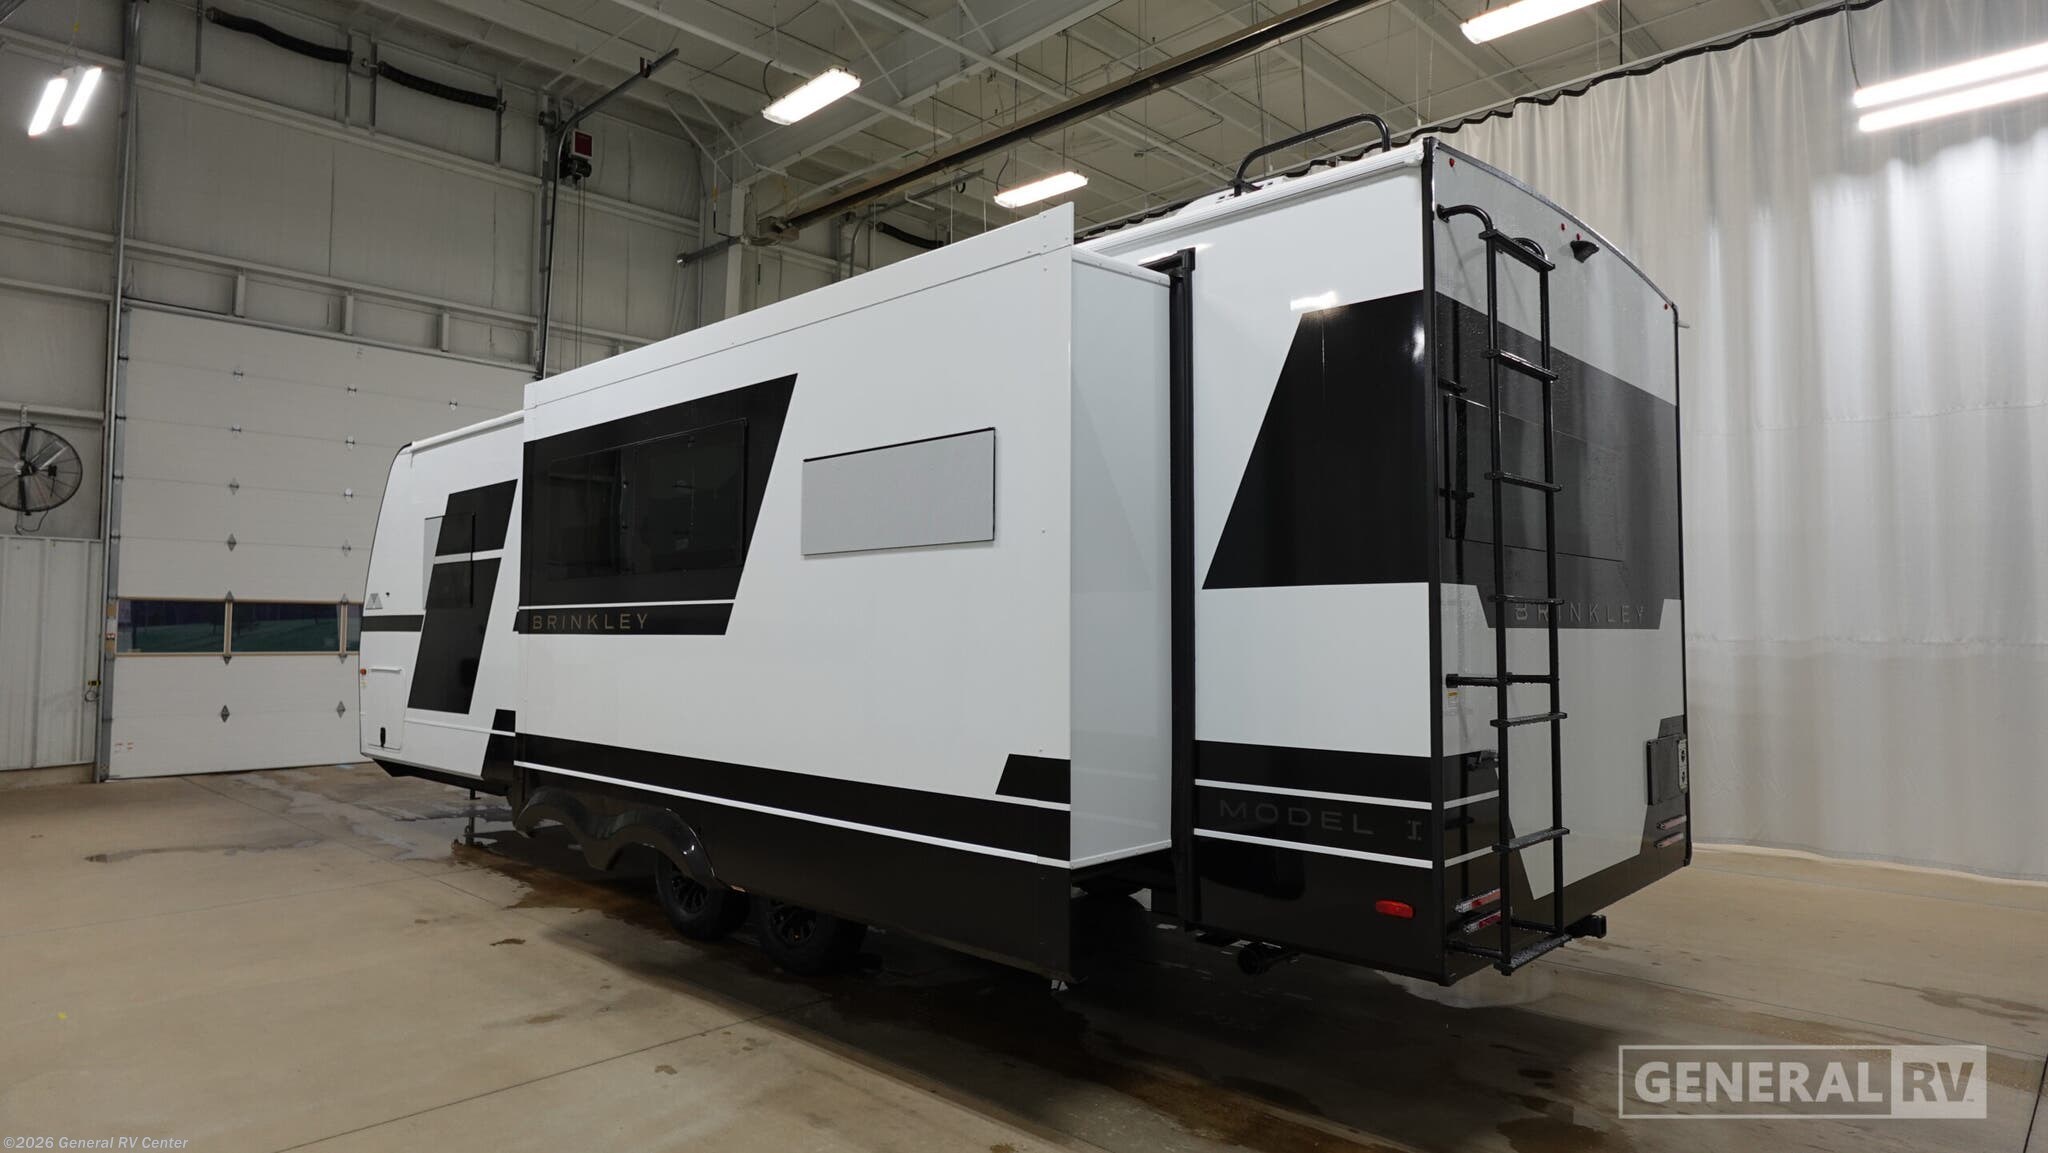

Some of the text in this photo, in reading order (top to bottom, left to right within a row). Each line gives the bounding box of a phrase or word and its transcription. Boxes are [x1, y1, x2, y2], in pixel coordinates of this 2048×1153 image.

[532, 613, 648, 630] BRINKLEY
[1513, 602, 1645, 624] BRINKLEY
[1219, 799, 1375, 836] MODEL
